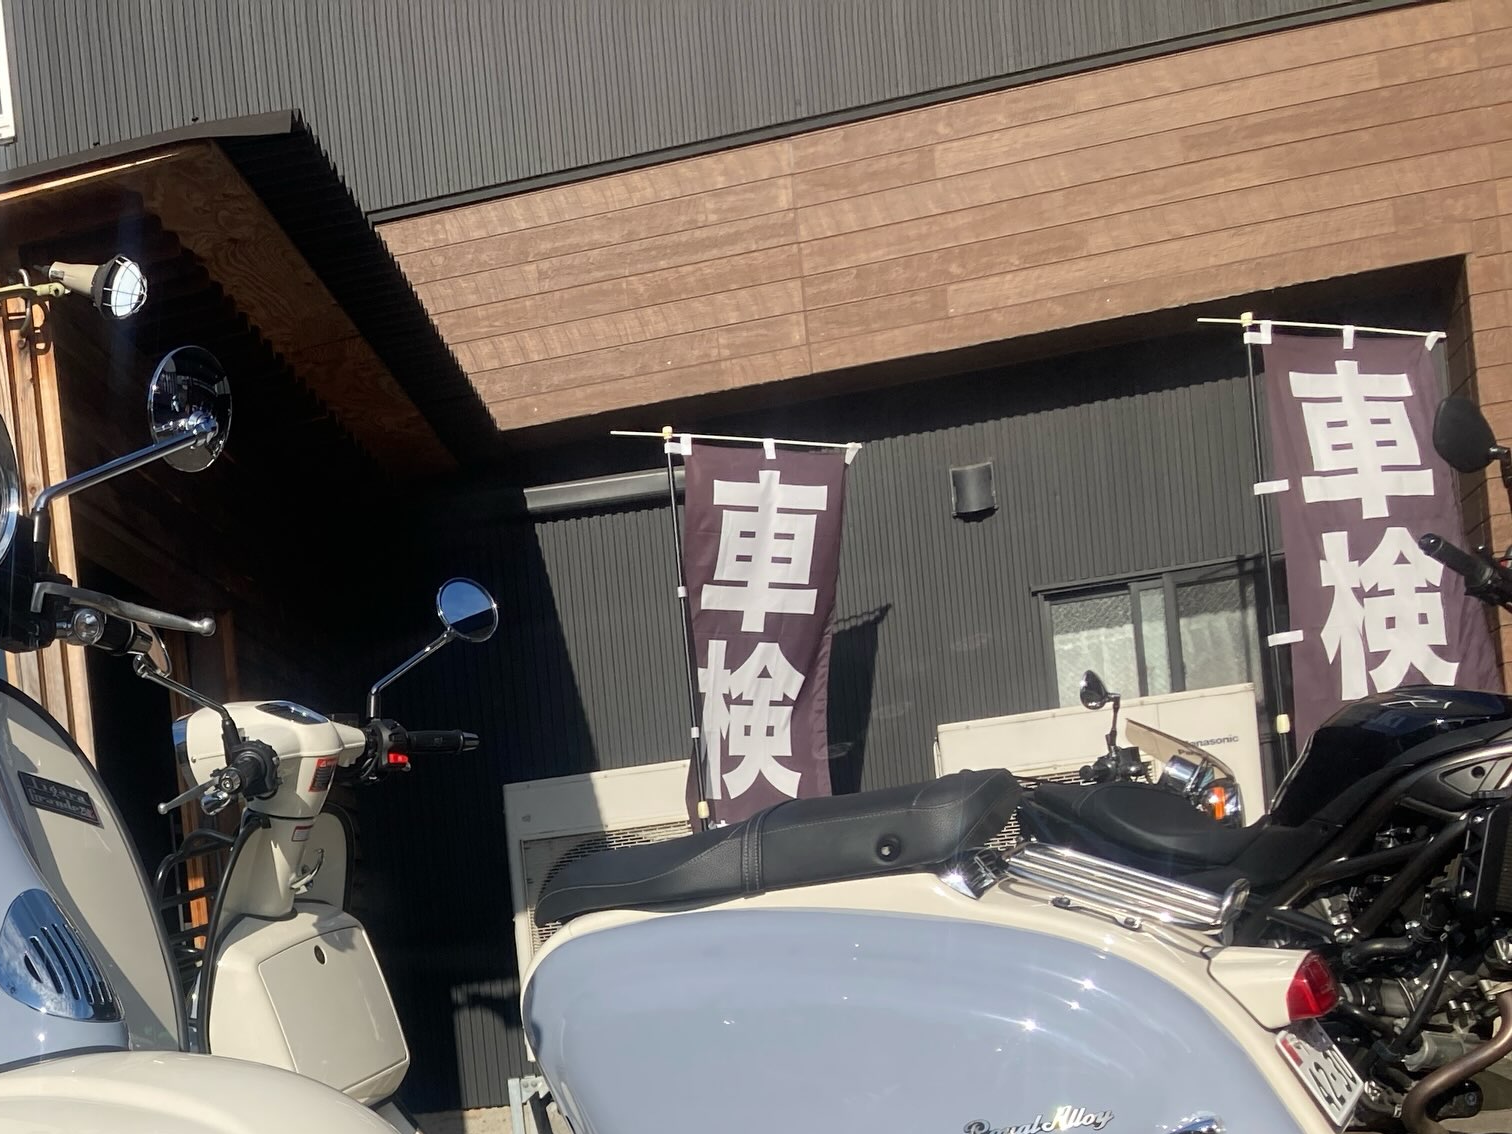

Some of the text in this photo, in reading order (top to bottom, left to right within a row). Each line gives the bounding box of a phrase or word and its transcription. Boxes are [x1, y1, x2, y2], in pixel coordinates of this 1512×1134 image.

[1289, 360, 1460, 701] 車検
[697, 470, 828, 800] 車検
[1189, 734, 1239, 748] anasonic
[1041, 1105, 1115, 1131] Alloy
